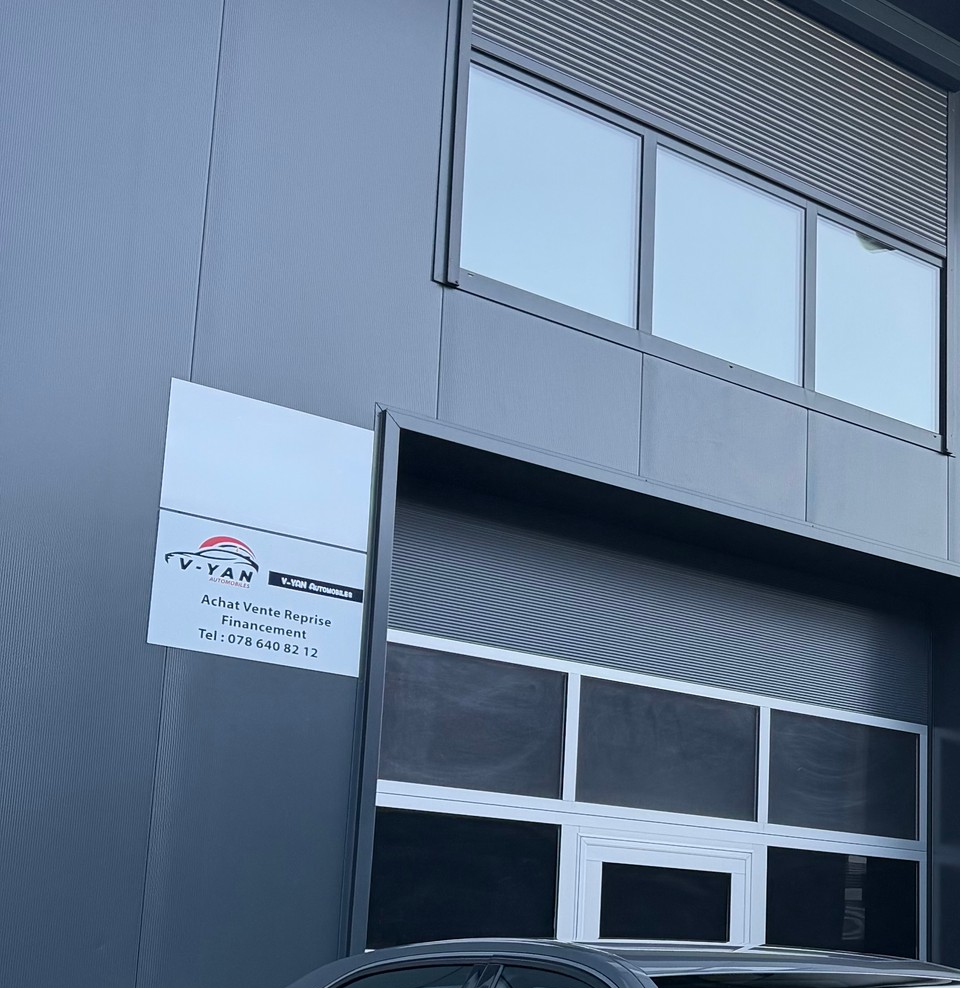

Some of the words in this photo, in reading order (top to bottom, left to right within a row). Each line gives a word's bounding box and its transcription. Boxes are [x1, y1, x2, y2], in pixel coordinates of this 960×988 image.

[179, 557, 253, 583] V-YAN
[209, 576, 250, 589] AUTOMOBILES
[281, 577, 307, 589] V-YAN
[201, 594, 240, 611] Achat
[243, 602, 281, 618] Vente
[284, 609, 332, 627] Reprise
[221, 615, 307, 640] Financement
[228, 633, 253, 646] 078
[256, 639, 280, 651] 640
[284, 643, 299, 655] 82
[304, 646, 318, 658] 12
